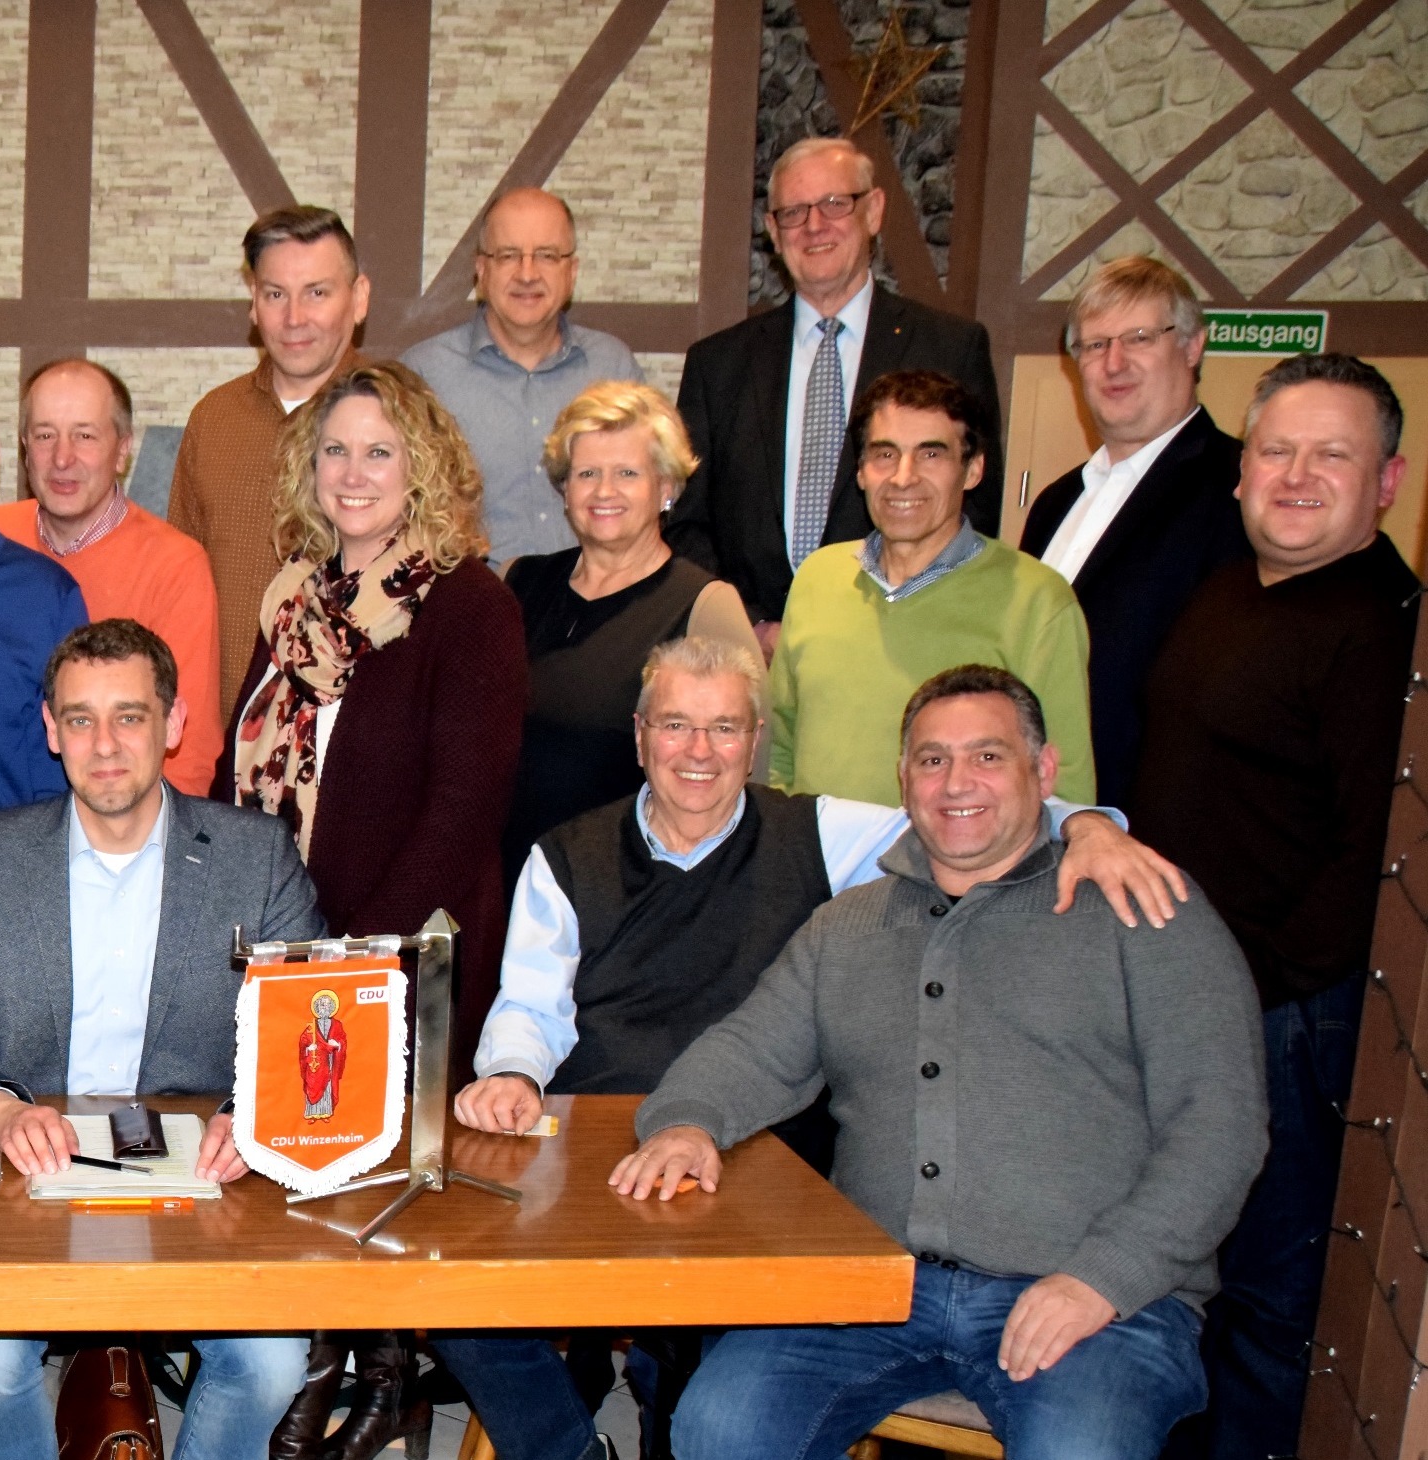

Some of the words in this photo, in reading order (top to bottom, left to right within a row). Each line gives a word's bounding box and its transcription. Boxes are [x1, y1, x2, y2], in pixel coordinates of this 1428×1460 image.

[1207, 320, 1319, 348] tausgang
[359, 990, 384, 1000] CDU
[270, 1136, 295, 1147] CDU
[298, 1132, 364, 1146] Winzenheim
